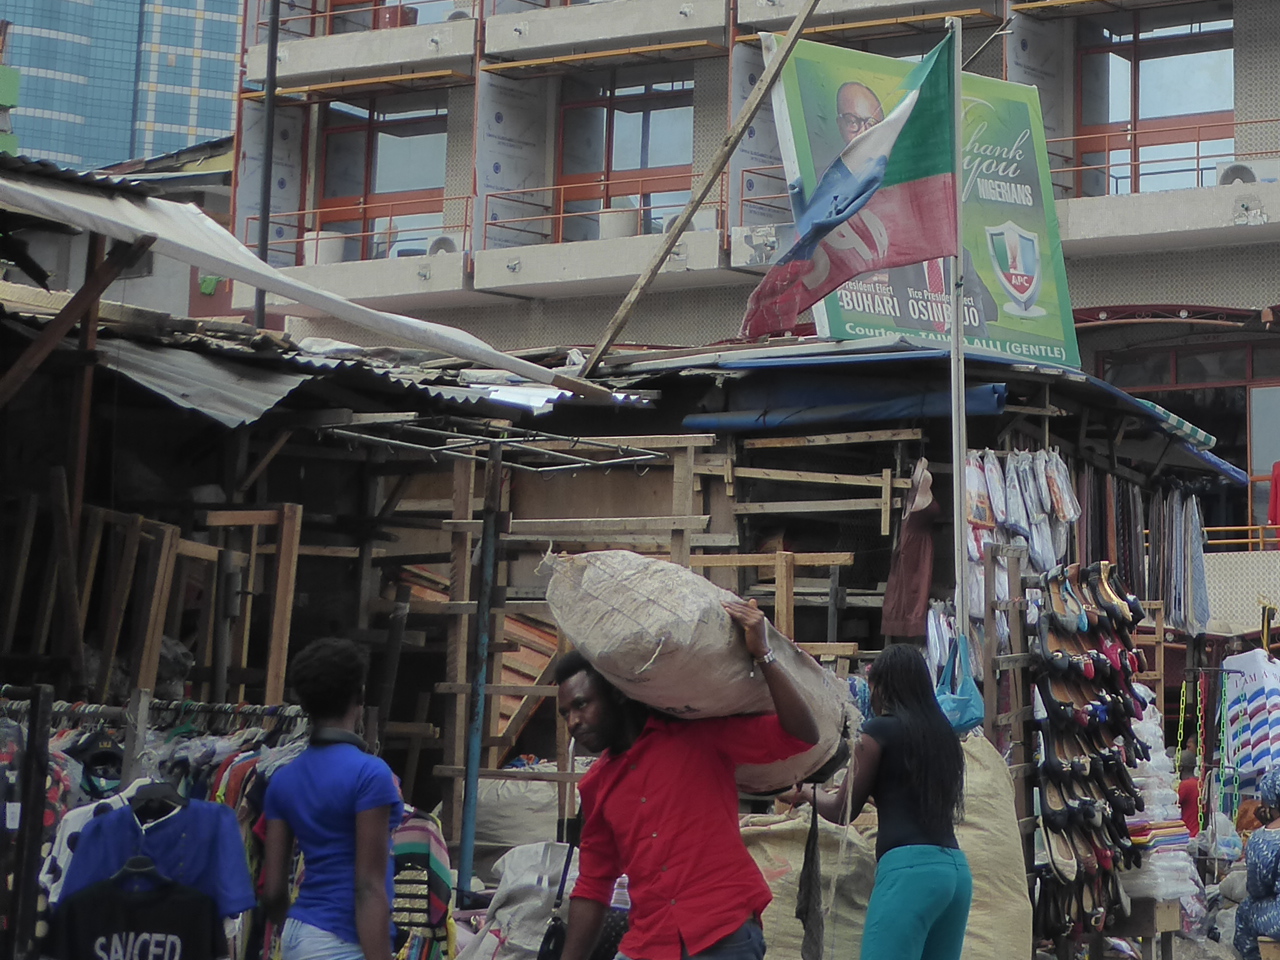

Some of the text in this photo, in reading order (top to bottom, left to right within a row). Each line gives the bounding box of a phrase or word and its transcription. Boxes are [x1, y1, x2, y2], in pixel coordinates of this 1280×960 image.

[961, 155, 1021, 203] you
[977, 178, 1034, 207] NIGERIANS
[844, 279, 894, 296] resident Elect
[907, 287, 923, 299] Vice
[1011, 274, 1030, 287] APC
[841, 289, 901, 317] BUHARI
[908, 298, 980, 327] OSINBJO
[974, 338, 1002, 352] ALLI
[1005, 341, 1067, 362] (GENTLE)
